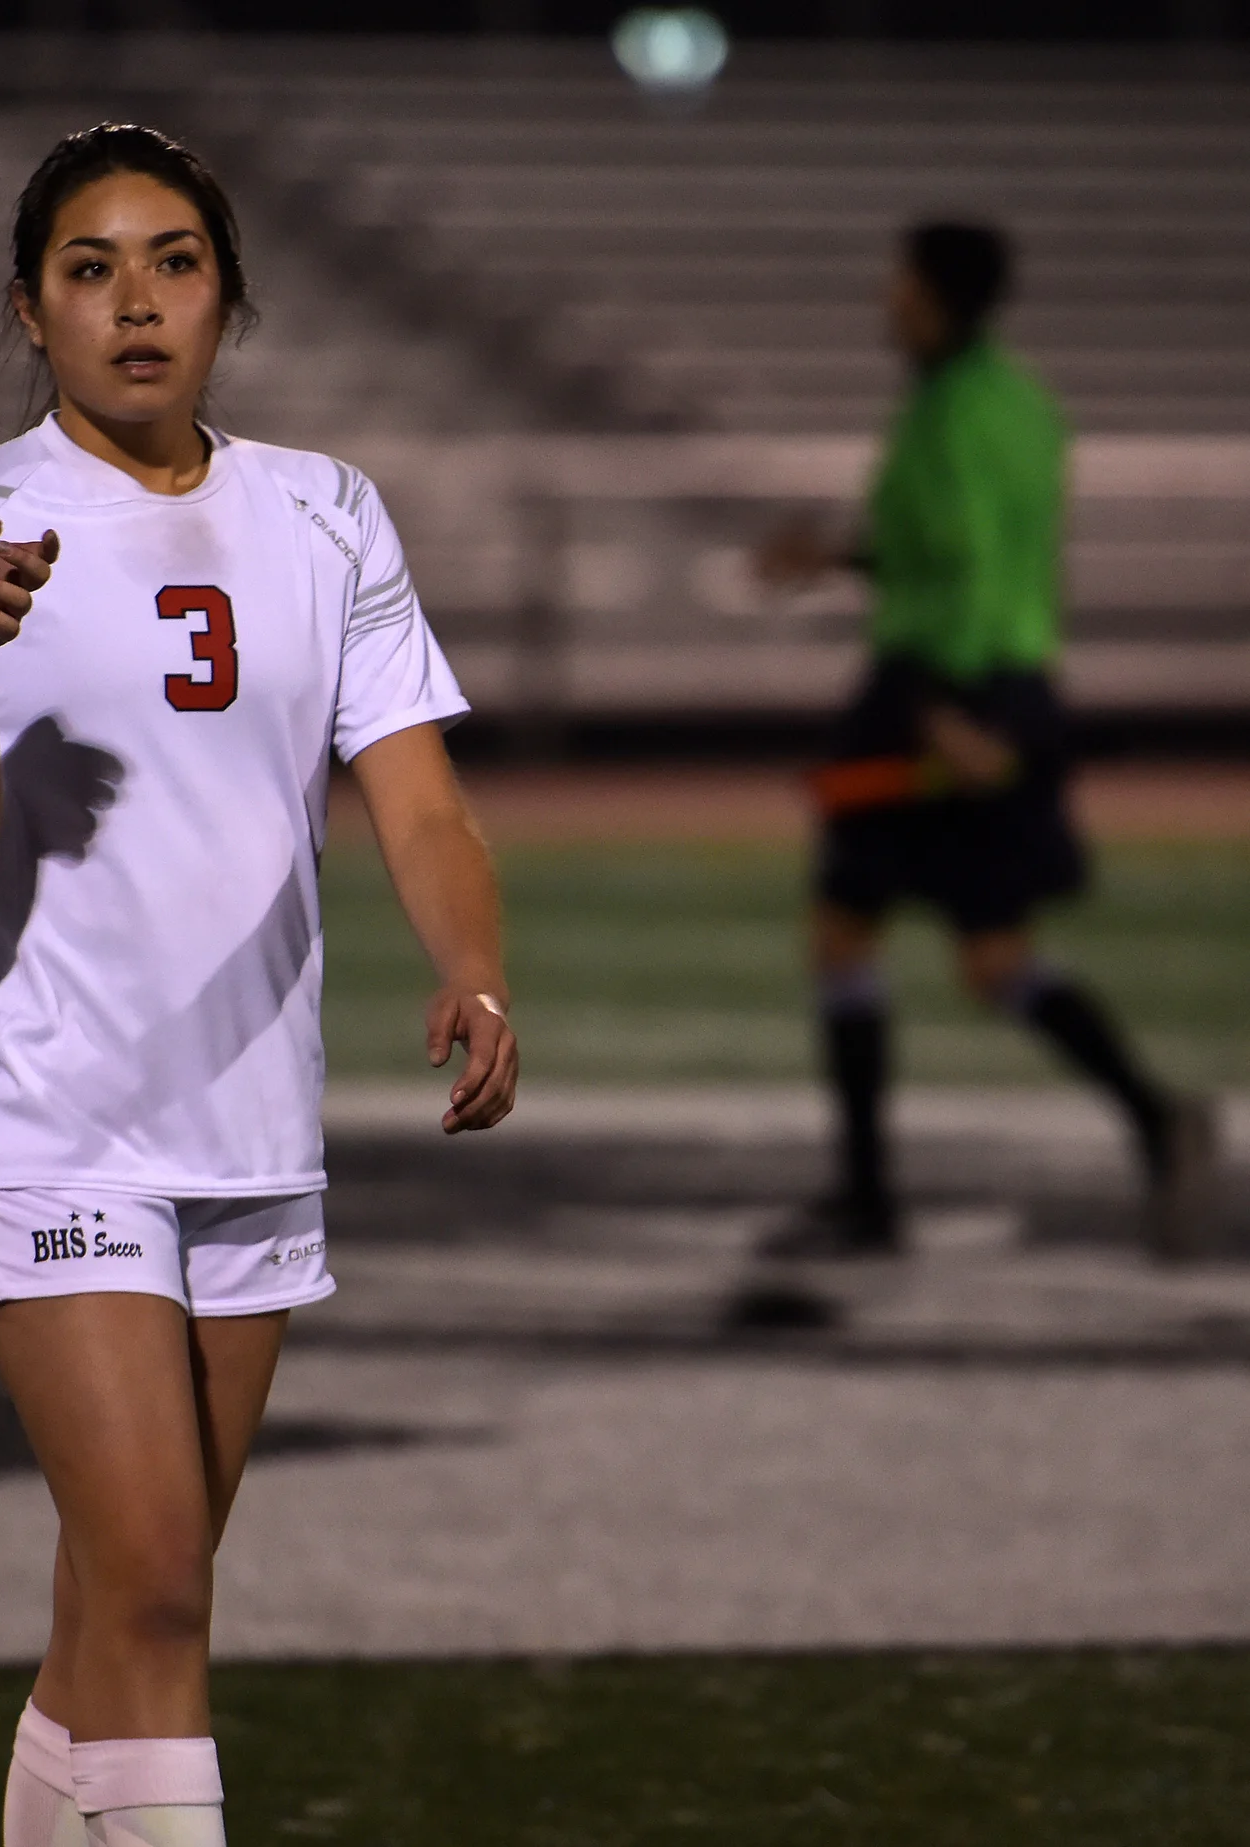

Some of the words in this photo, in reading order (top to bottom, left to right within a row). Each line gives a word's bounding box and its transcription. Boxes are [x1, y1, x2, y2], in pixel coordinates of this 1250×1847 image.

[155, 585, 238, 712] 3
[31, 1227, 87, 1263] BHS
[94, 1231, 143, 1257] Soccer
